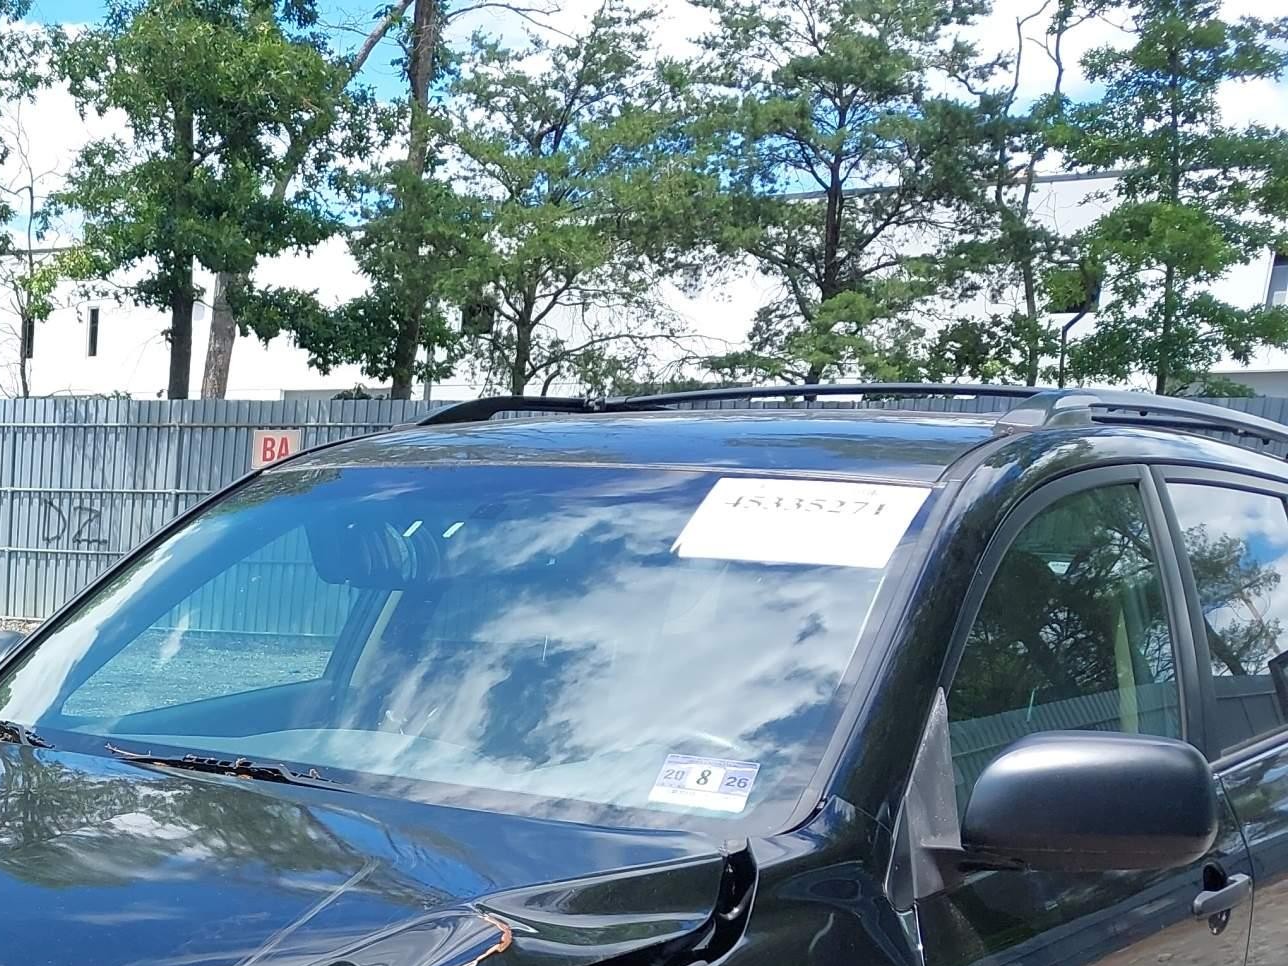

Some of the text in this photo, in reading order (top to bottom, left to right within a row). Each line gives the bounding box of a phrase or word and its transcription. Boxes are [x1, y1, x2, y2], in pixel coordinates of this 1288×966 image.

[263, 437, 289, 462] BA
[724, 495, 887, 517] 45335271
[696, 769, 713, 786] 8
[725, 776, 750, 789] 26
